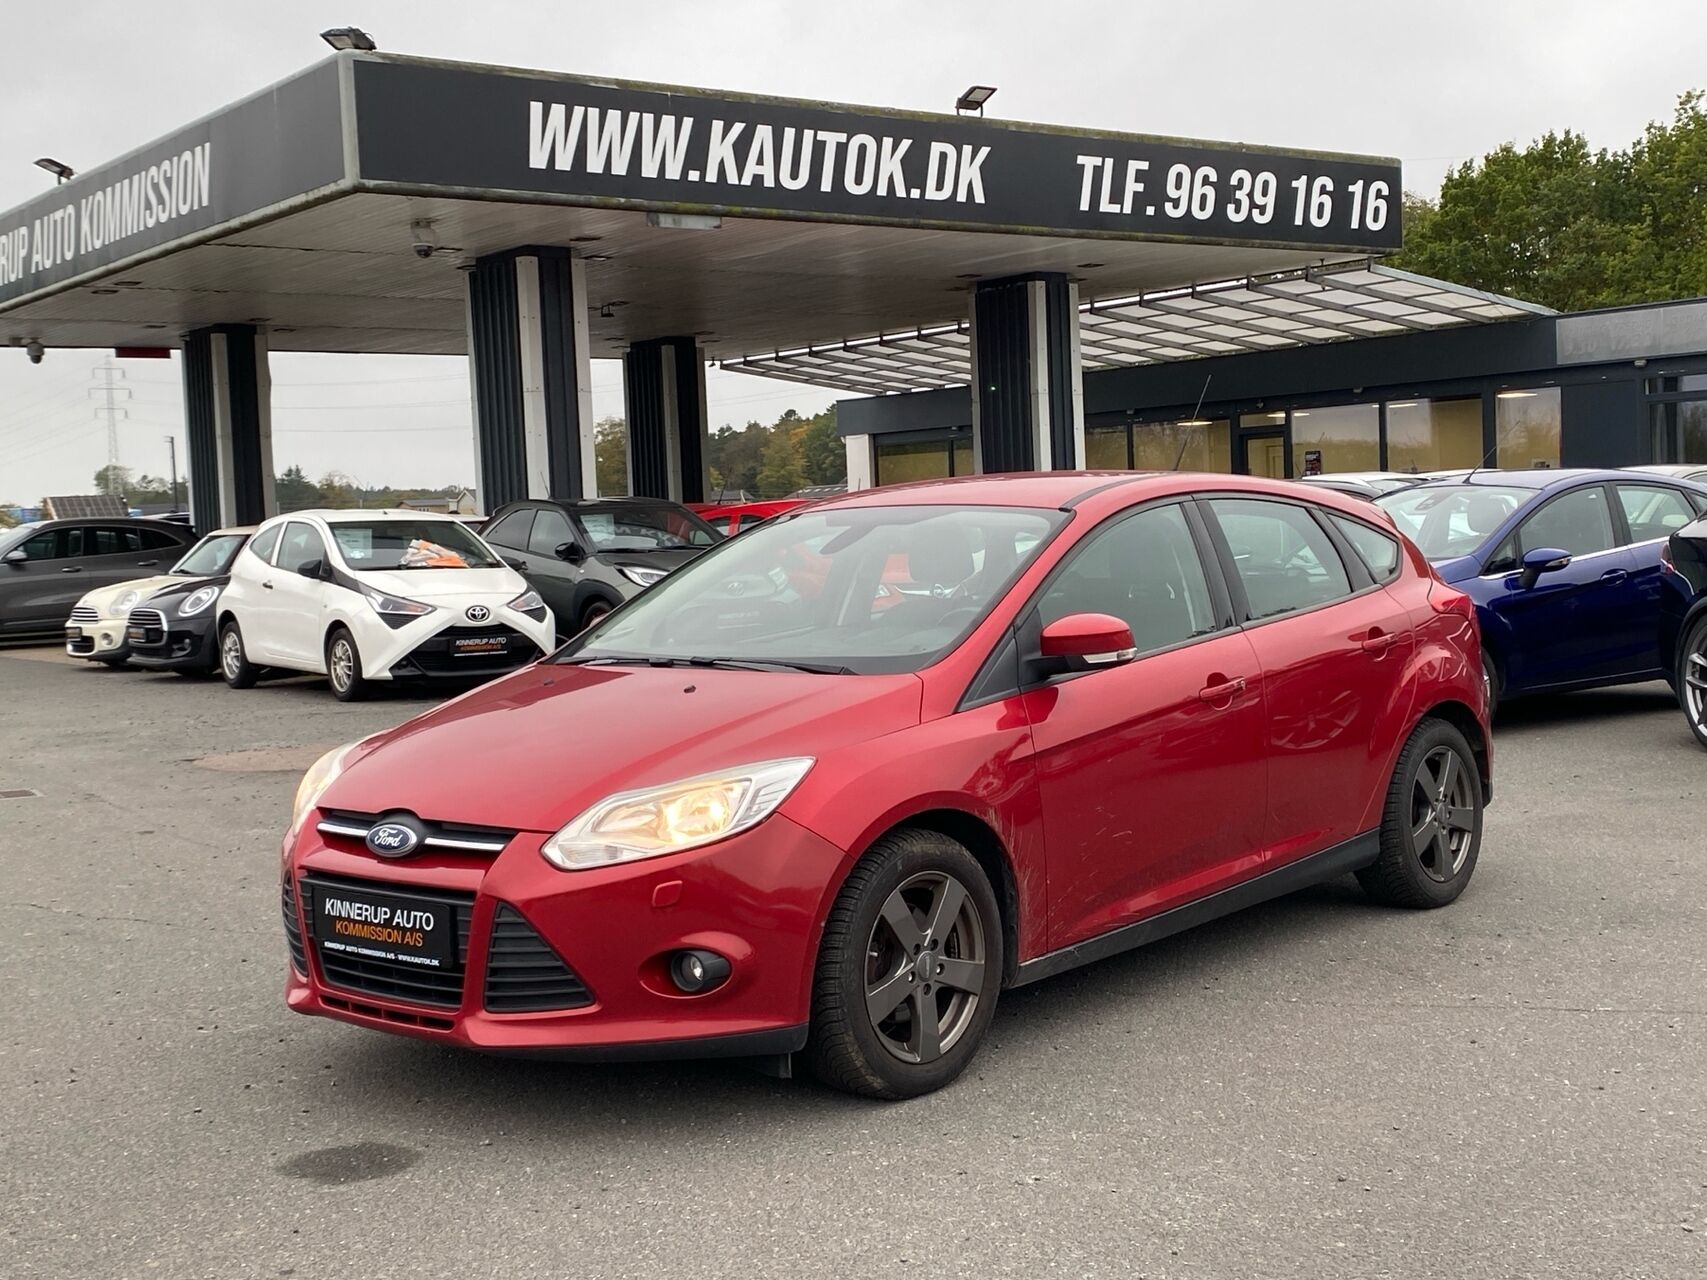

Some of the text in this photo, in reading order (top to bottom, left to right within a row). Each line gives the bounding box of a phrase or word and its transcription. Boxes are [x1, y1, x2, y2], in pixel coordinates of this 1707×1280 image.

[529, 101, 991, 204] WWW.KAUTOK.DK
[31, 204, 75, 273] AUTO
[80, 142, 210, 255] KOMMISSION
[1076, 154, 1389, 232] TLF. 96 39 16 16
[489, 636, 507, 645] AUTO
[374, 827, 403, 847] Ford
[324, 898, 435, 931] KINNERUP AUTO
[335, 920, 423, 947] KOMMISSION A/S
